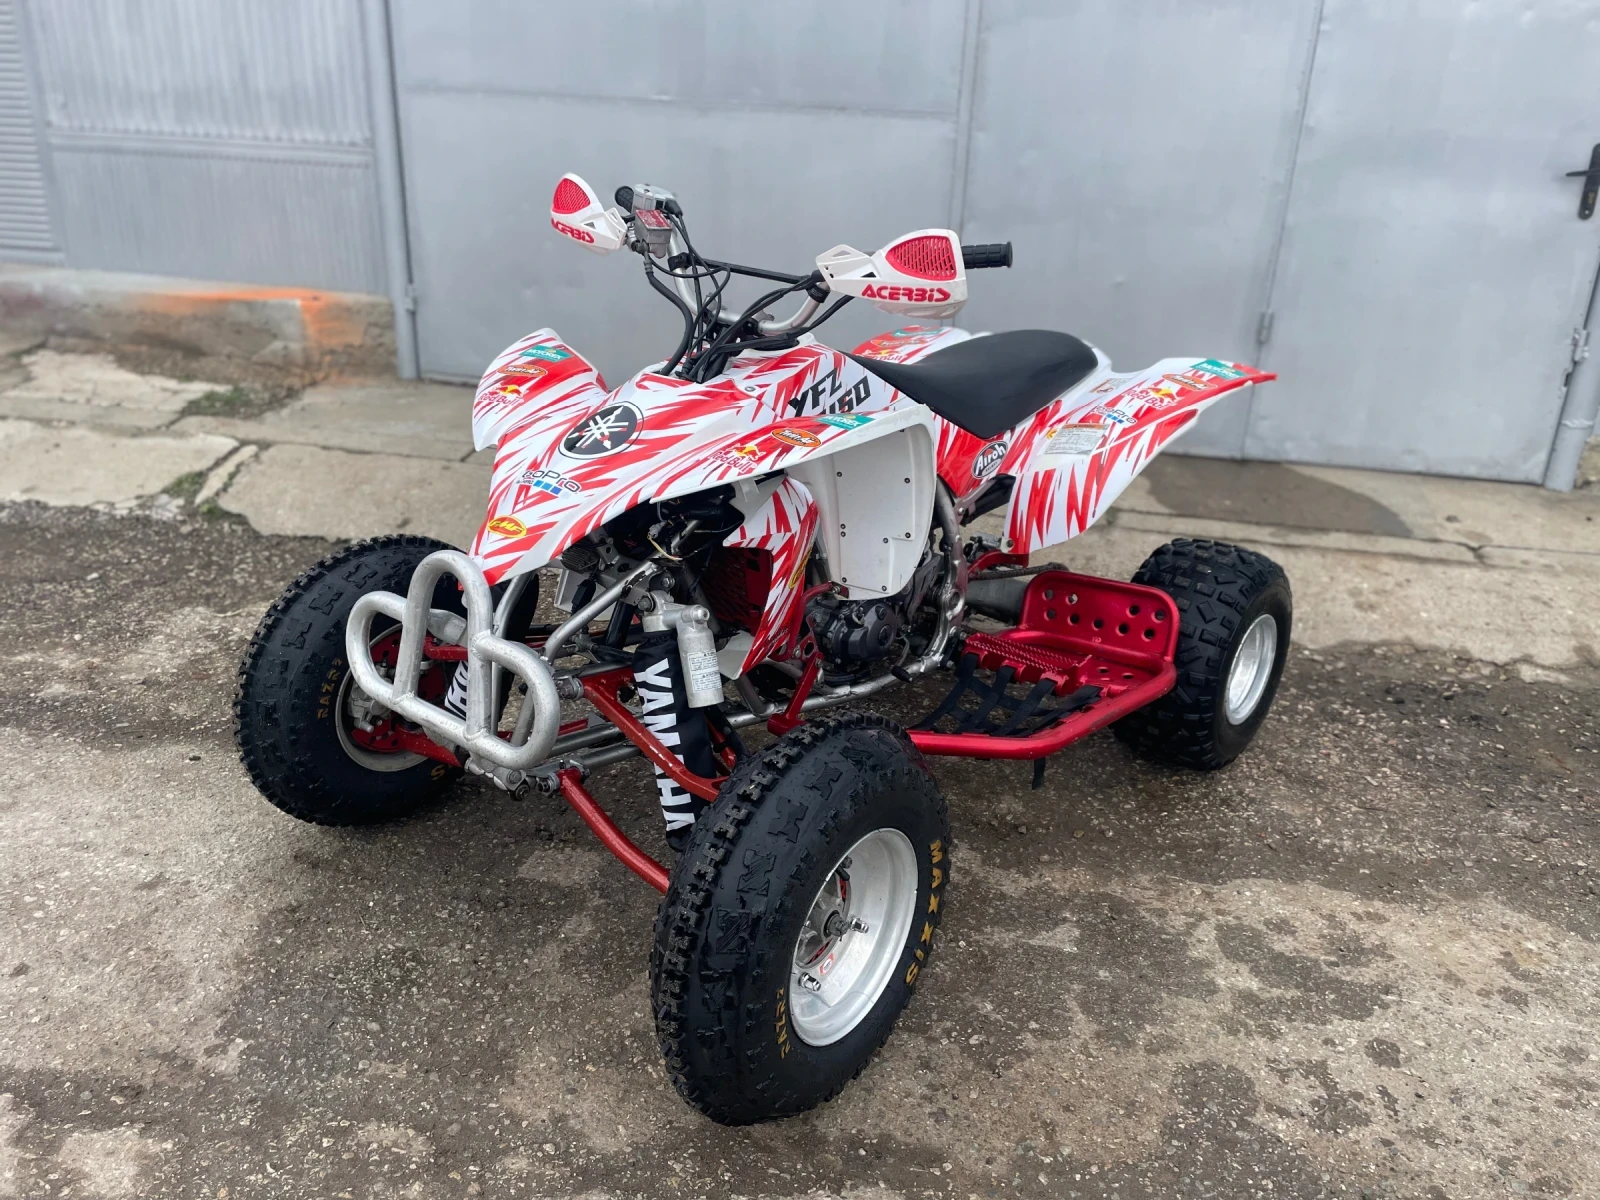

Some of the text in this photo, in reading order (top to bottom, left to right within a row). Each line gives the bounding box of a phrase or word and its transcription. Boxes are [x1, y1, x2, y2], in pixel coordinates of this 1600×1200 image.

[788, 367, 843, 417] YFZ
[709, 450, 754, 474] Red Bull
[975, 443, 1006, 477] Airoh
[521, 469, 581, 493] GoPro
[907, 839, 943, 987] MAXXIS
